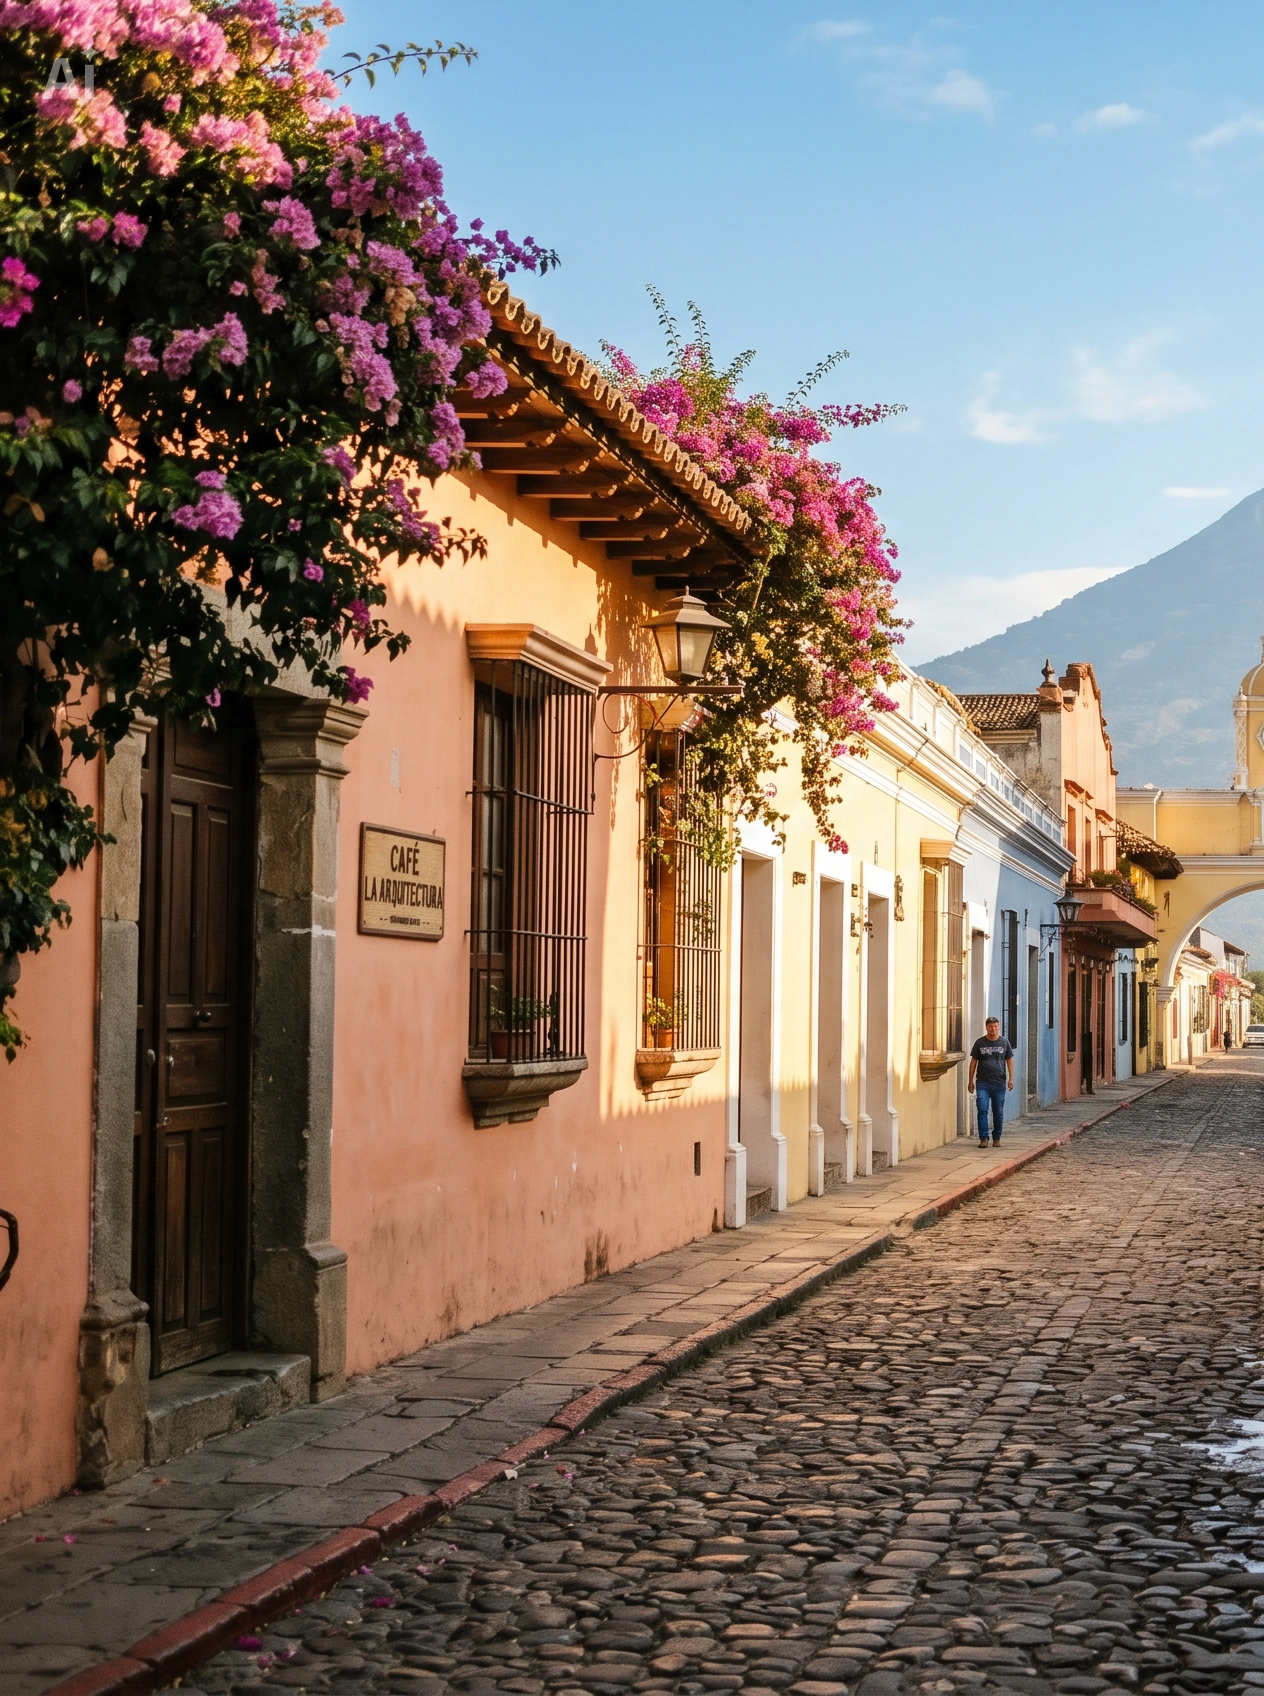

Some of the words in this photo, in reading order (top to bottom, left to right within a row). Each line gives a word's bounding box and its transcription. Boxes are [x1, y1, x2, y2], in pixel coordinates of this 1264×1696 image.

[390, 841, 420, 876] CAFÉ
[364, 875, 377, 902] LA
[379, 877, 443, 910] ARQUITECTURA
